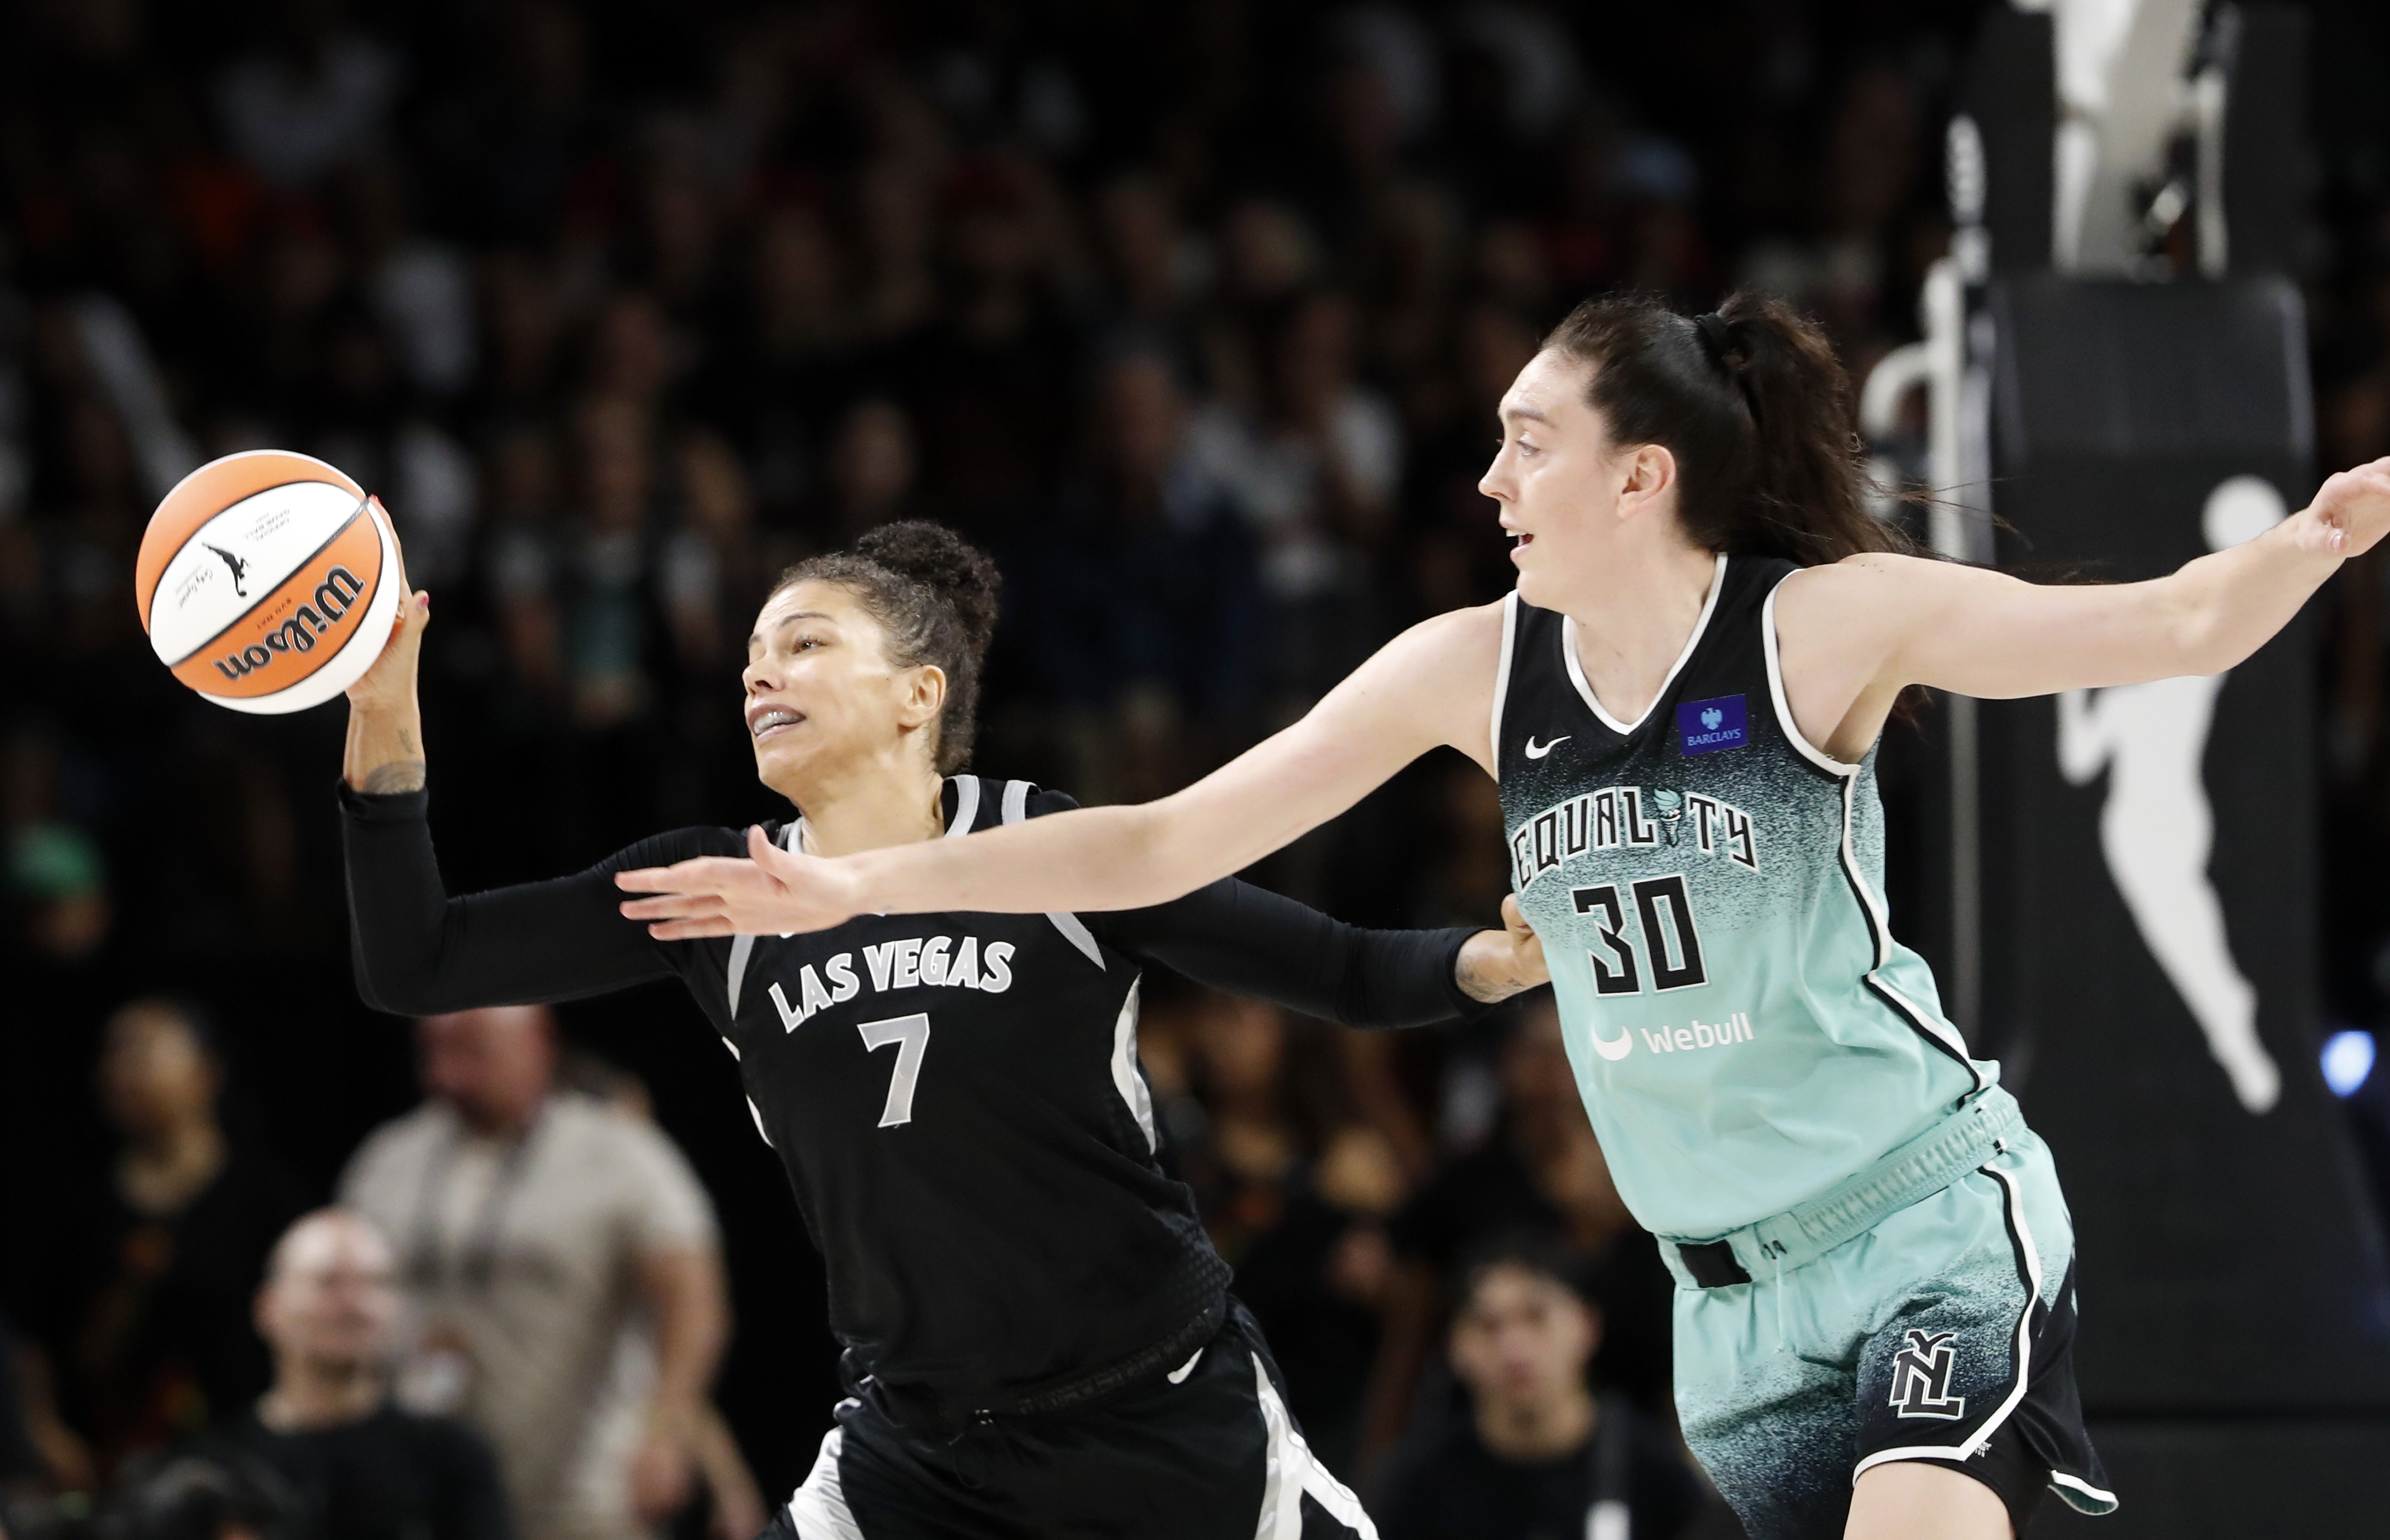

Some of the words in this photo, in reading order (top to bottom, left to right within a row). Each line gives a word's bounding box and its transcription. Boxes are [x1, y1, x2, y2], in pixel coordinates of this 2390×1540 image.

[211, 565, 366, 680] Wilson
[1687, 727, 1741, 747] BARCLAYS
[768, 953, 860, 1034] LAS
[862, 935, 1016, 993] VEGAS
[1570, 874, 1710, 997] 30
[857, 1012, 930, 1128] 7
[1640, 1012, 1755, 1055] Webull
